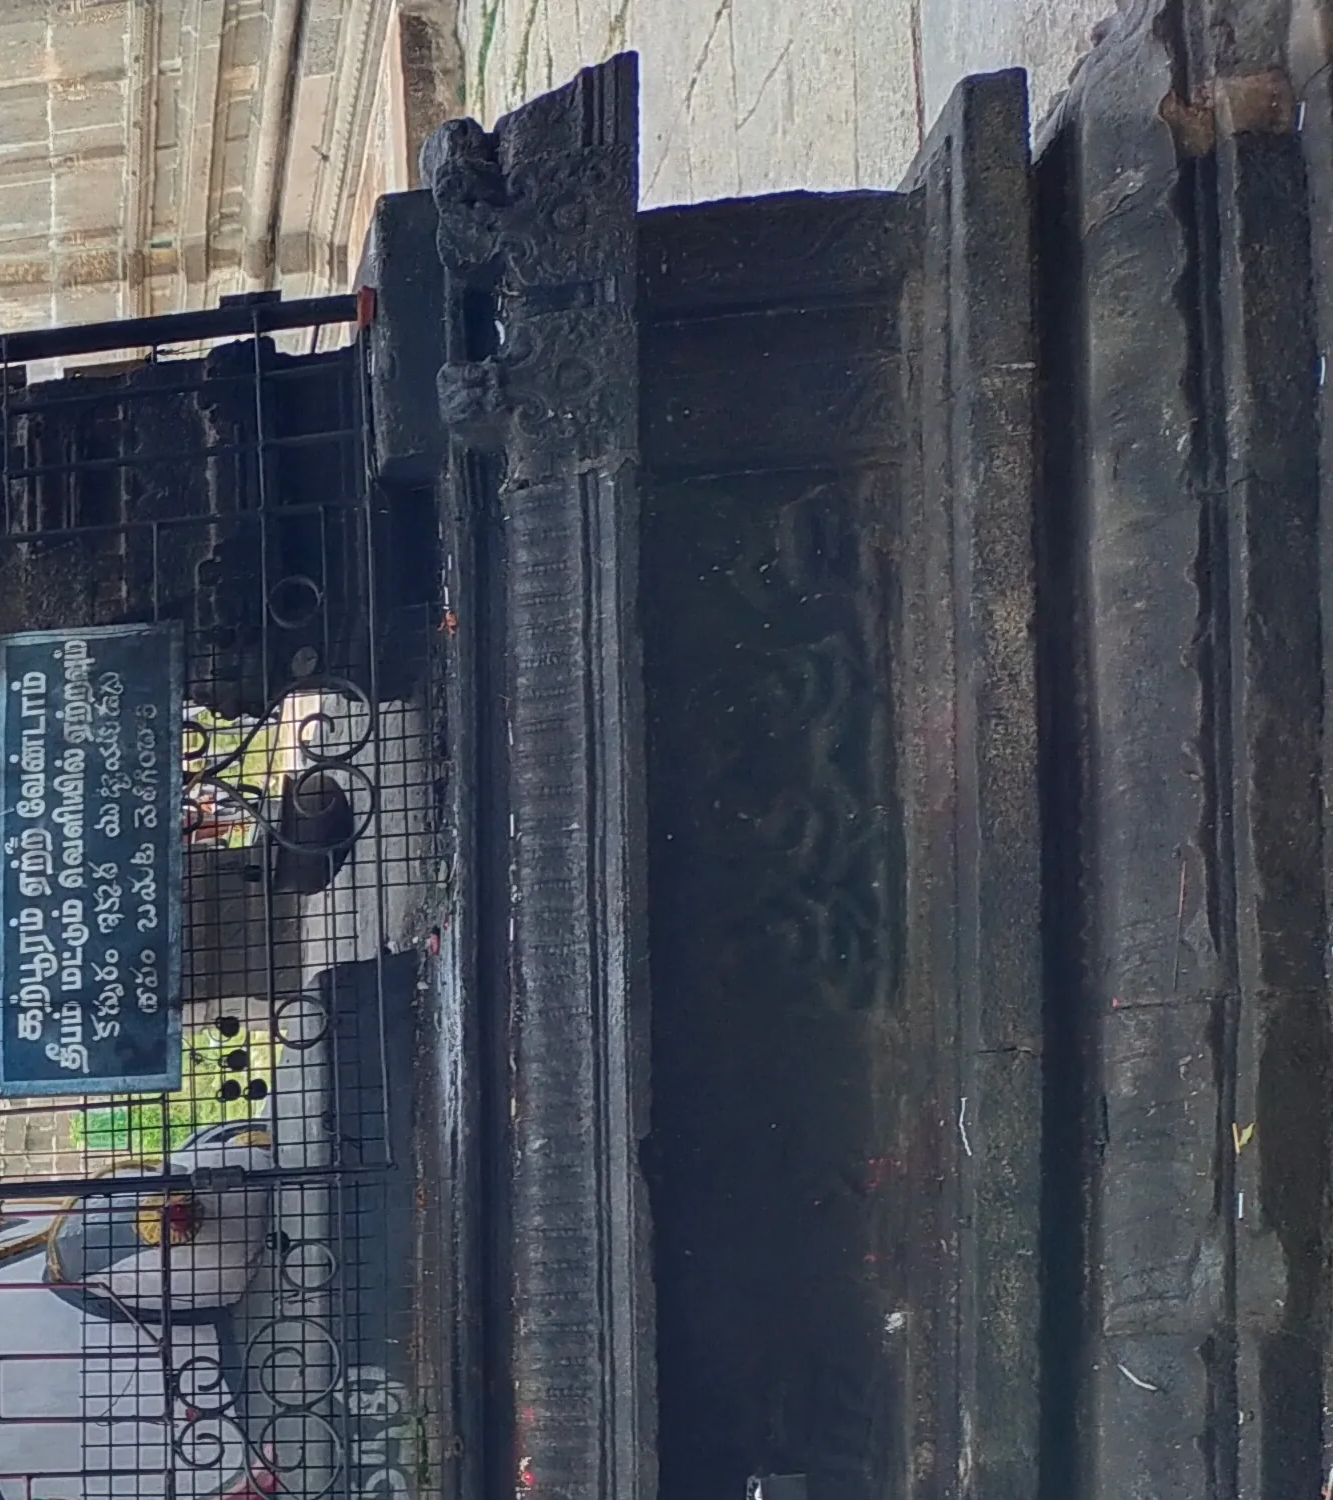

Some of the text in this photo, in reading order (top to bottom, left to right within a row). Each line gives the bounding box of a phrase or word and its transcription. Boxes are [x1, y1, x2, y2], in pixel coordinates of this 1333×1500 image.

[9, 670, 46, 818] வேண்டாம்
[44, 639, 96, 1074] தீபம் மட்டும் வெளியில் ஏற்றவும்
[9, 907, 58, 1041] கற்பூரம்
